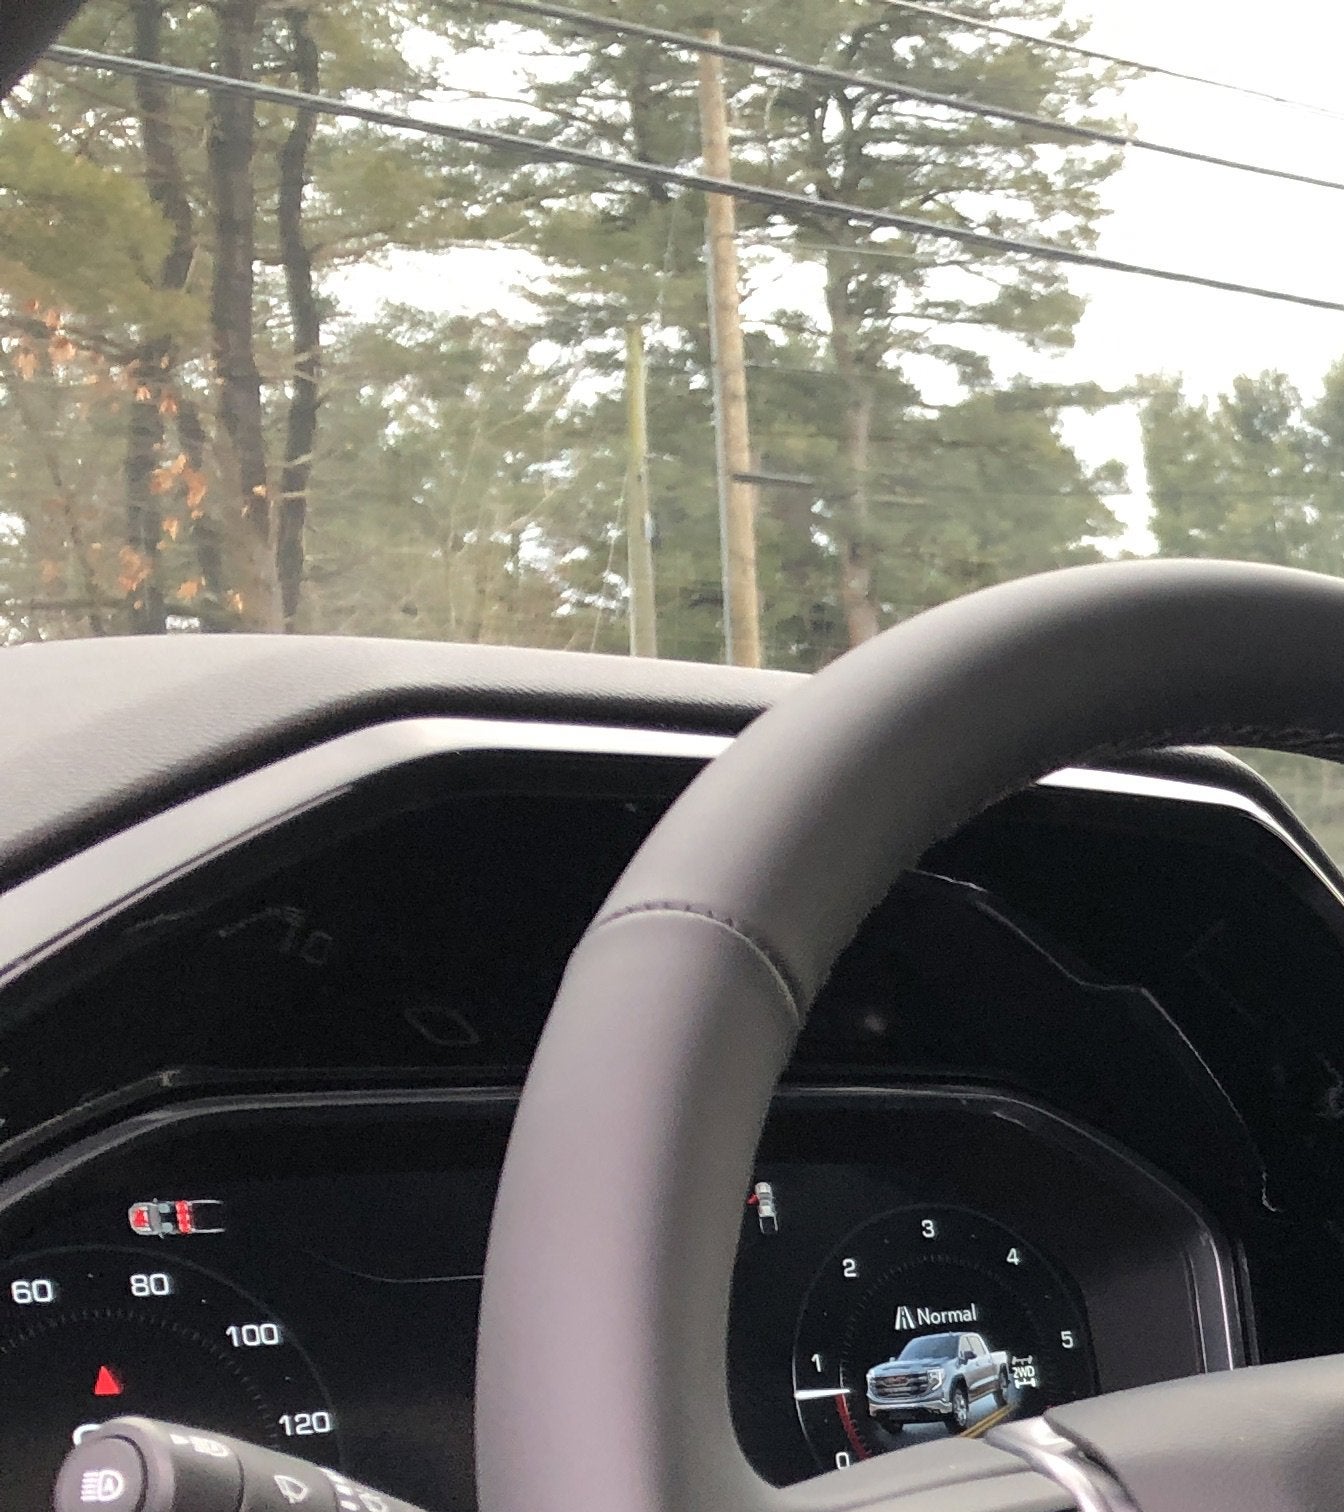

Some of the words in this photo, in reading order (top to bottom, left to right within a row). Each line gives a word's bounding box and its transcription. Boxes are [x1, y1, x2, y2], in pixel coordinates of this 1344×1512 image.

[921, 1219, 936, 1239] 3
[1005, 1247, 1021, 1266] 4
[842, 1258, 857, 1278] 2
[11, 1279, 54, 1305] 60
[129, 1272, 171, 1297] 80
[916, 1304, 978, 1326] Normal
[226, 1323, 280, 1347] 100
[1060, 1330, 1074, 1349] 5
[811, 1354, 824, 1373] 1
[1012, 1365, 1036, 1379] 2WD
[278, 1411, 333, 1436] 120
[835, 1452, 851, 1471] 0
